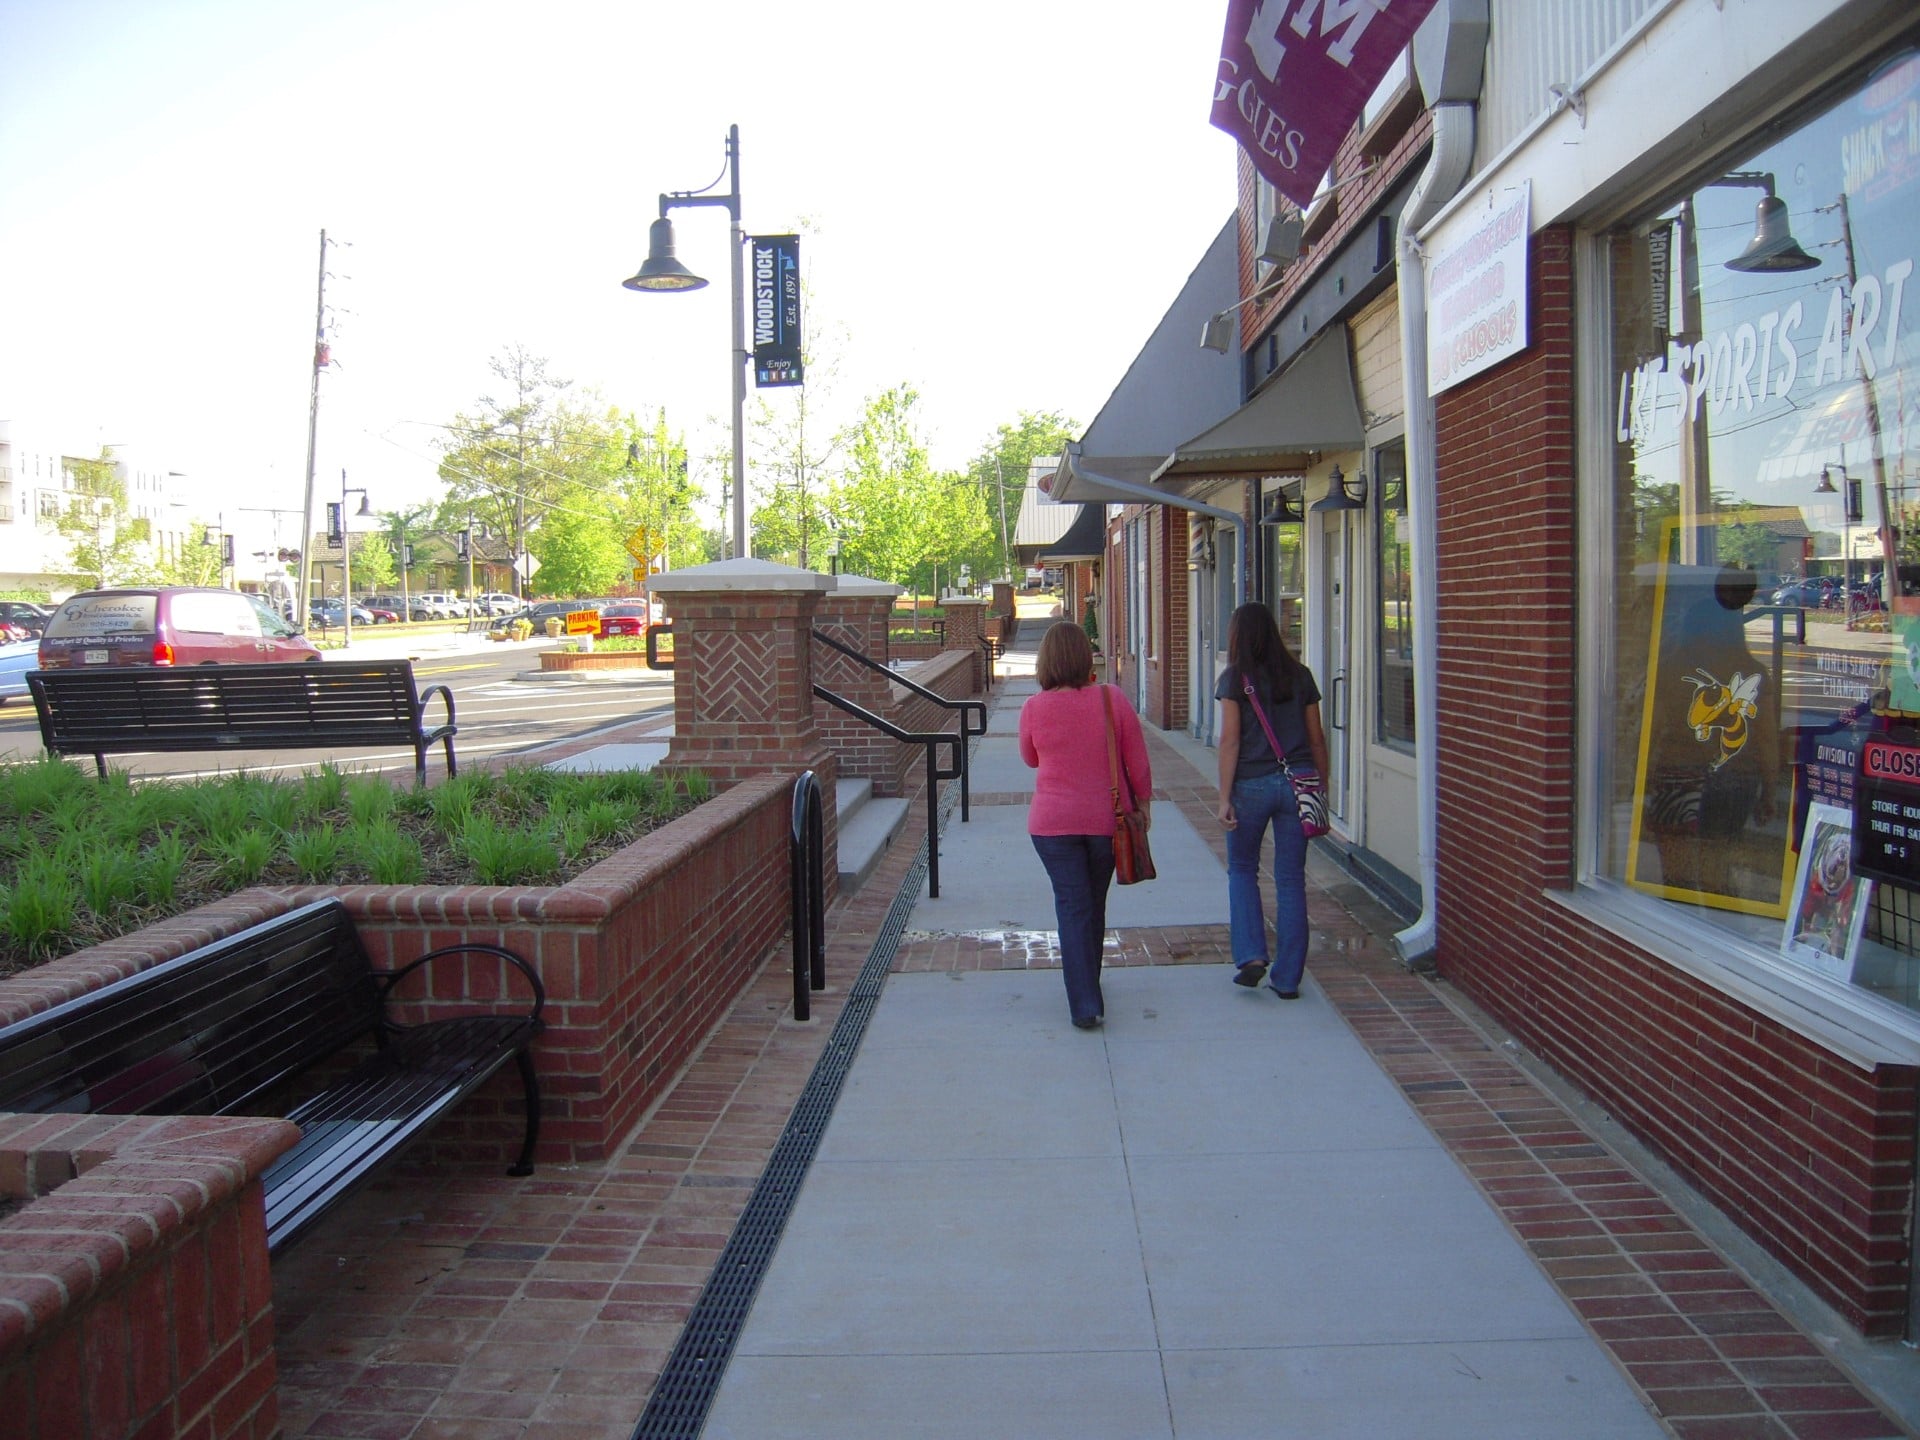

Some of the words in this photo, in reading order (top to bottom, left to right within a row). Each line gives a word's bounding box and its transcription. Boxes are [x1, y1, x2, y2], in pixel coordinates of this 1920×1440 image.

[756, 248, 774, 345] WOODSTOCK
[785, 274, 796, 300] 1897
[785, 304, 796, 327] Est.
[1452, 300, 1517, 372] SCHOOLS
[1672, 301, 1803, 426] SPORTS
[1814, 258, 1913, 387] ART
[766, 360, 792, 371] Enjoy
[83, 604, 144, 612] Cherokee
[568, 611, 598, 624] PARKING
[51, 638, 74, 646] Comfort
[83, 637, 106, 645] Quality
[1816, 652, 1847, 673] WORLD
[1849, 655, 1878, 679] SERIES
[1823, 677, 1870, 703] CHAMPIONS
[1818, 745, 1846, 765] DIVISION
[1871, 800, 1898, 815] STORE
[1871, 820, 1890, 833] THUR
[1892, 825, 1905, 837] FRI
[1907, 828, 1920, 841] SAT
